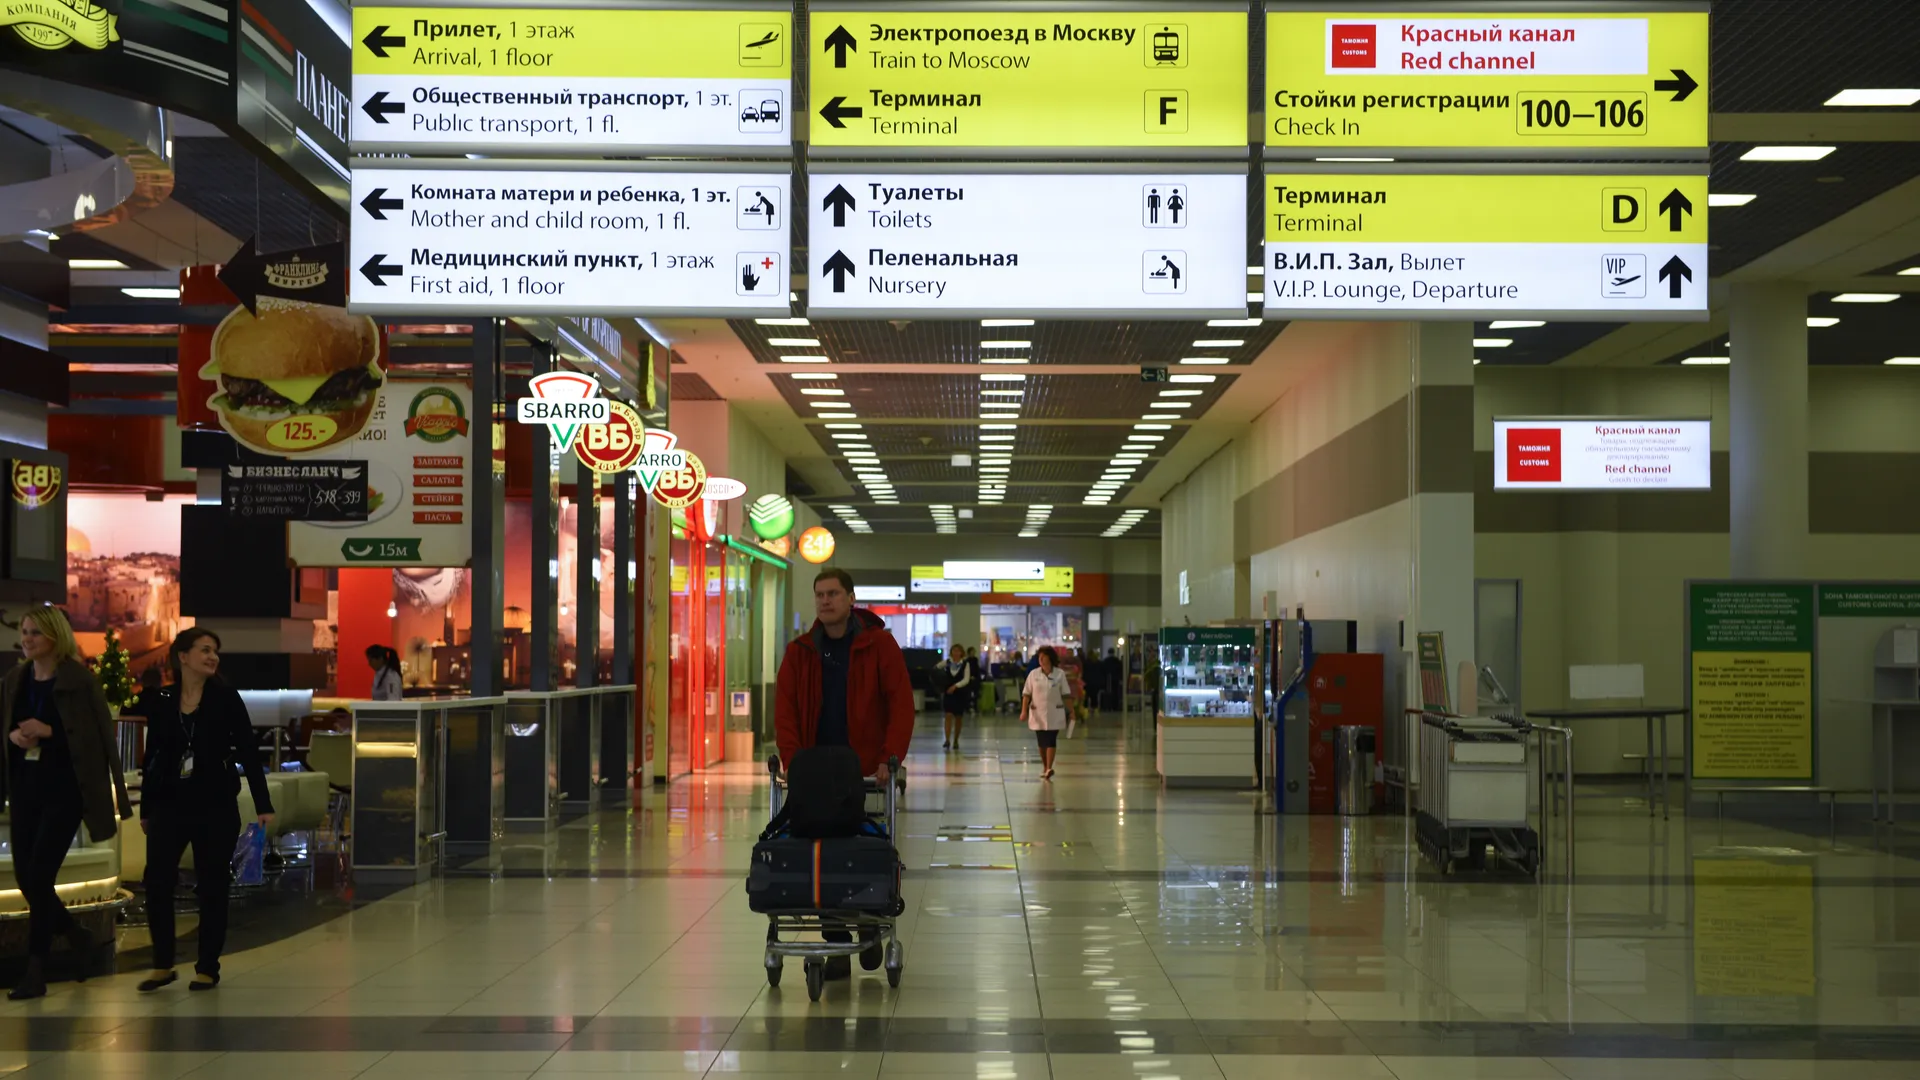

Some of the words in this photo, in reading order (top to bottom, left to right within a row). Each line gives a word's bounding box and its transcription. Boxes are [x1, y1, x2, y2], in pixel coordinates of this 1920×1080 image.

[7, 4, 77, 31] КОМПАНИЯ
[413, 19, 501, 40] Прилет,
[510, 21, 517, 38] 1
[526, 25, 575, 39] этаж
[870, 24, 1029, 44] Электропоезд
[1035, 28, 1047, 41] в
[1053, 24, 1136, 45] Москву
[1401, 24, 1502, 44] Красный
[1509, 28, 1575, 41] канал
[413, 49, 482, 69] Arrival,
[490, 50, 497, 66] 1
[506, 48, 553, 67] floor
[870, 51, 915, 68] Train
[923, 53, 942, 68] to
[949, 52, 1030, 69] Moscow
[1401, 53, 1442, 70] Red
[1448, 51, 1535, 70] channel
[412, 87, 573, 107] Общественный
[578, 92, 689, 110] транспорт,
[695, 91, 702, 106] 1
[710, 93, 732, 107] эт.
[870, 90, 982, 110] Терминал
[1274, 91, 1356, 108] Стойки
[1363, 94, 1509, 112] регистрации
[1160, 97, 1177, 125] F
[413, 114, 473, 132] Public
[480, 117, 578, 137] transport,
[586, 116, 593, 133] 1
[601, 115, 620, 133] fl.
[870, 117, 958, 134] Terminal
[1274, 118, 1335, 136] Check
[1343, 118, 1359, 136] In
[411, 184, 495, 201] Комната
[501, 188, 573, 205] матери
[580, 189, 592, 202] и
[598, 185, 685, 206] ребенка,
[692, 187, 700, 202] 1
[707, 190, 731, 203] эт.
[869, 183, 964, 205] Туалеты
[1274, 187, 1386, 206] Терминал
[869, 211, 932, 228] Toilets
[1612, 195, 1638, 224] D
[411, 210, 485, 228] Mother
[491, 211, 528, 229] and
[536, 210, 583, 229] child
[590, 215, 648, 233] room,
[657, 214, 664, 229] 1
[672, 212, 690, 230] fl.
[1274, 214, 1363, 232] Terminal
[411, 248, 568, 269] Медицинский
[574, 253, 643, 272] пункт,
[651, 252, 658, 268] 1
[666, 255, 714, 269] этаж
[869, 249, 1018, 267] Пеленальная
[1274, 253, 1341, 270] В.И.П.
[1349, 253, 1394, 273] Зал,
[1401, 254, 1465, 270] Вылет
[1606, 259, 1626, 274] VIP
[275, 276, 320, 286] БУРГЕР
[411, 276, 452, 294] First
[458, 276, 493, 296] aid,
[502, 278, 509, 294] 1
[517, 277, 565, 295] floor
[869, 277, 946, 298] Nursery
[1274, 281, 1316, 299] V.I.P.
[1323, 281, 1405, 302] Lounge,
[1413, 281, 1518, 302] Departure
[524, 403, 604, 419] SBARRO
[589, 424, 631, 450] ВБ
[1595, 425, 1645, 436] Красный
[417, 458, 459, 466] ЗАВТРАКИ
[595, 461, 621, 471] 2002
[634, 453, 681, 467] ARRO
[1605, 465, 1626, 474] Red
[1629, 464, 1672, 474] channel
[422, 494, 454, 502] СТЕЙКИ
[705, 484, 729, 494] OSCO
